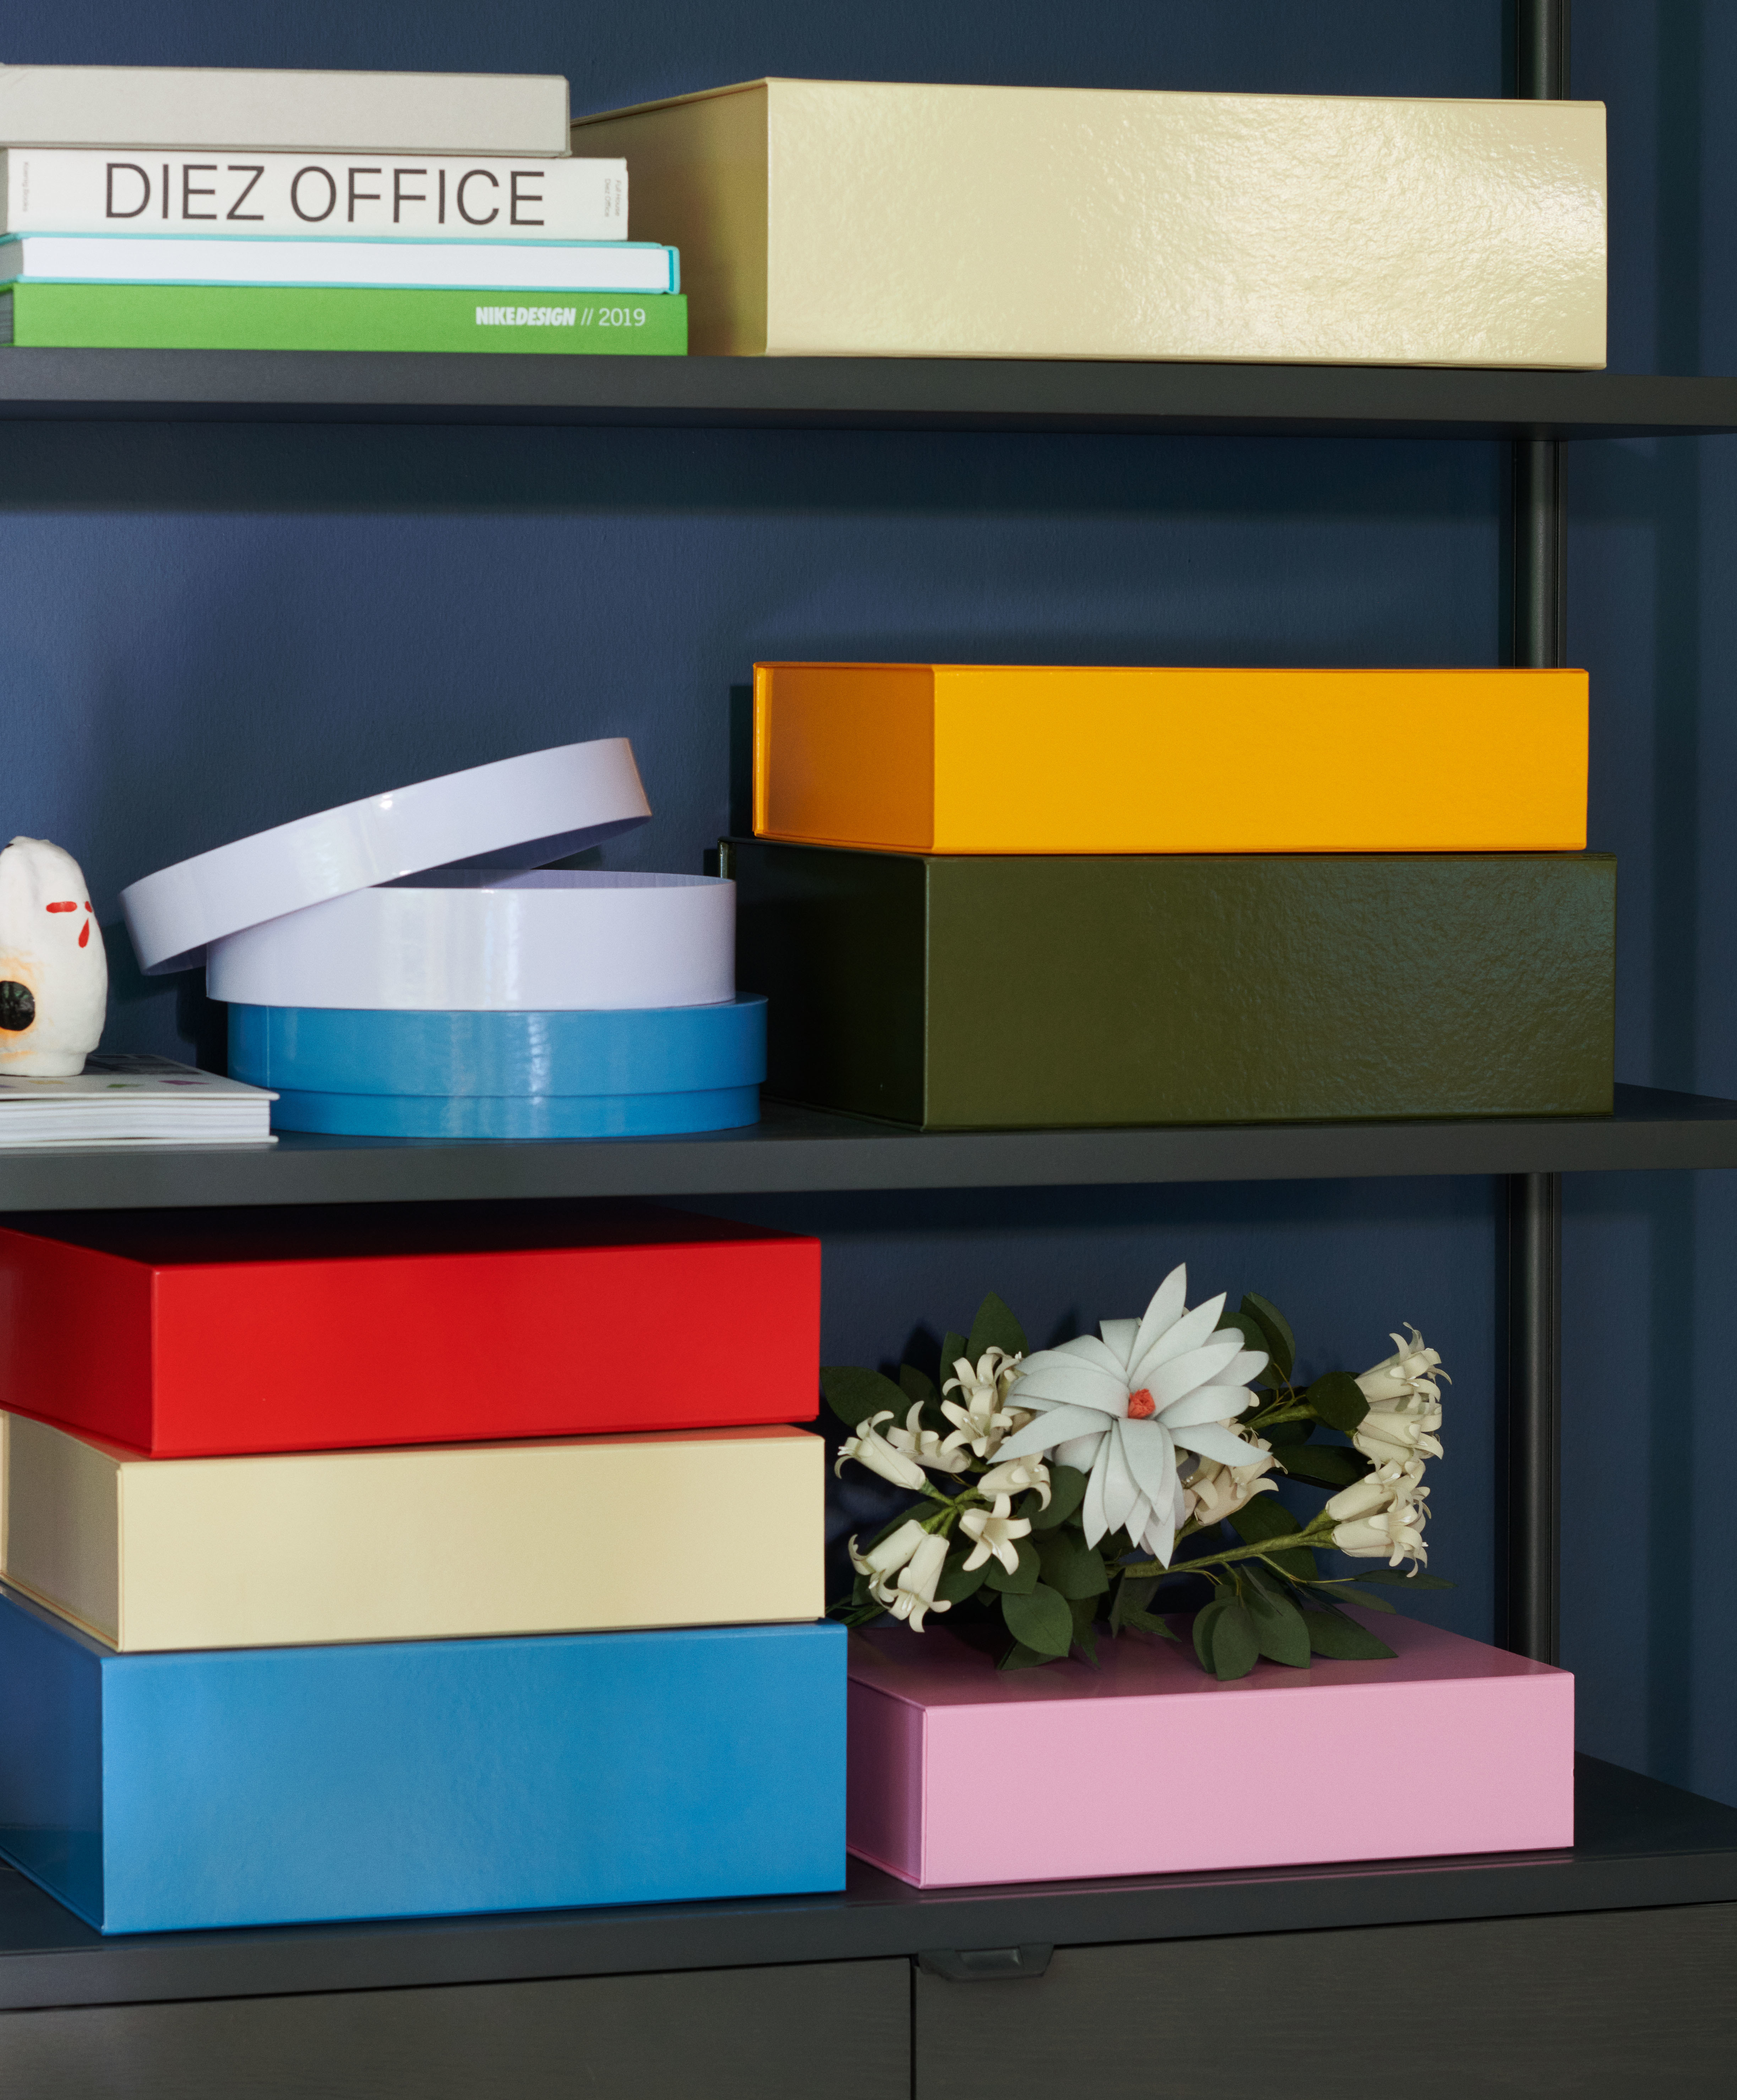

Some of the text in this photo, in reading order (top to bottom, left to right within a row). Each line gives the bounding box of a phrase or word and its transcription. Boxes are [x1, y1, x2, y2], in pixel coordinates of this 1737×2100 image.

[106, 163, 545, 226] DIEZ OFFICE
[598, 308, 646, 327] 2019
